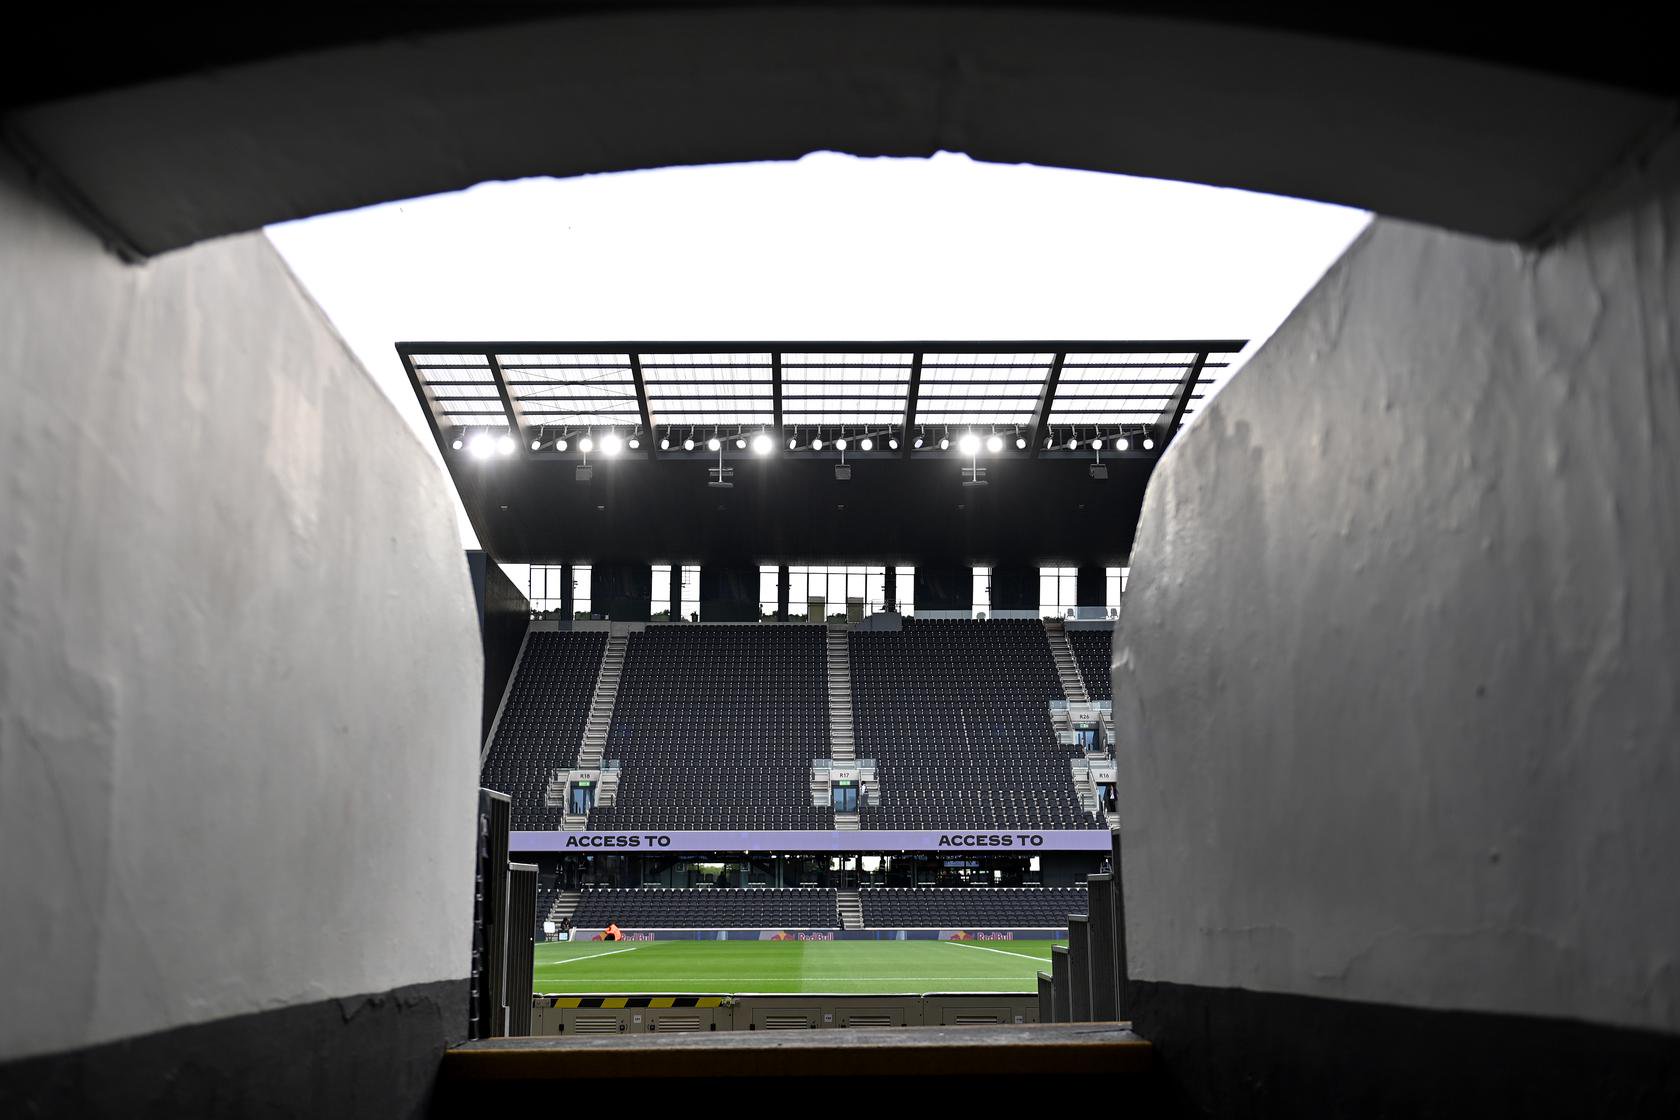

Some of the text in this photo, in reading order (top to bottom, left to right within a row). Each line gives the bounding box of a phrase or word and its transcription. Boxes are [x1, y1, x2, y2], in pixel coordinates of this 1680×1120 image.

[566, 836, 671, 847] ACCESS TO
[939, 835, 1044, 846] ACCESS TO
